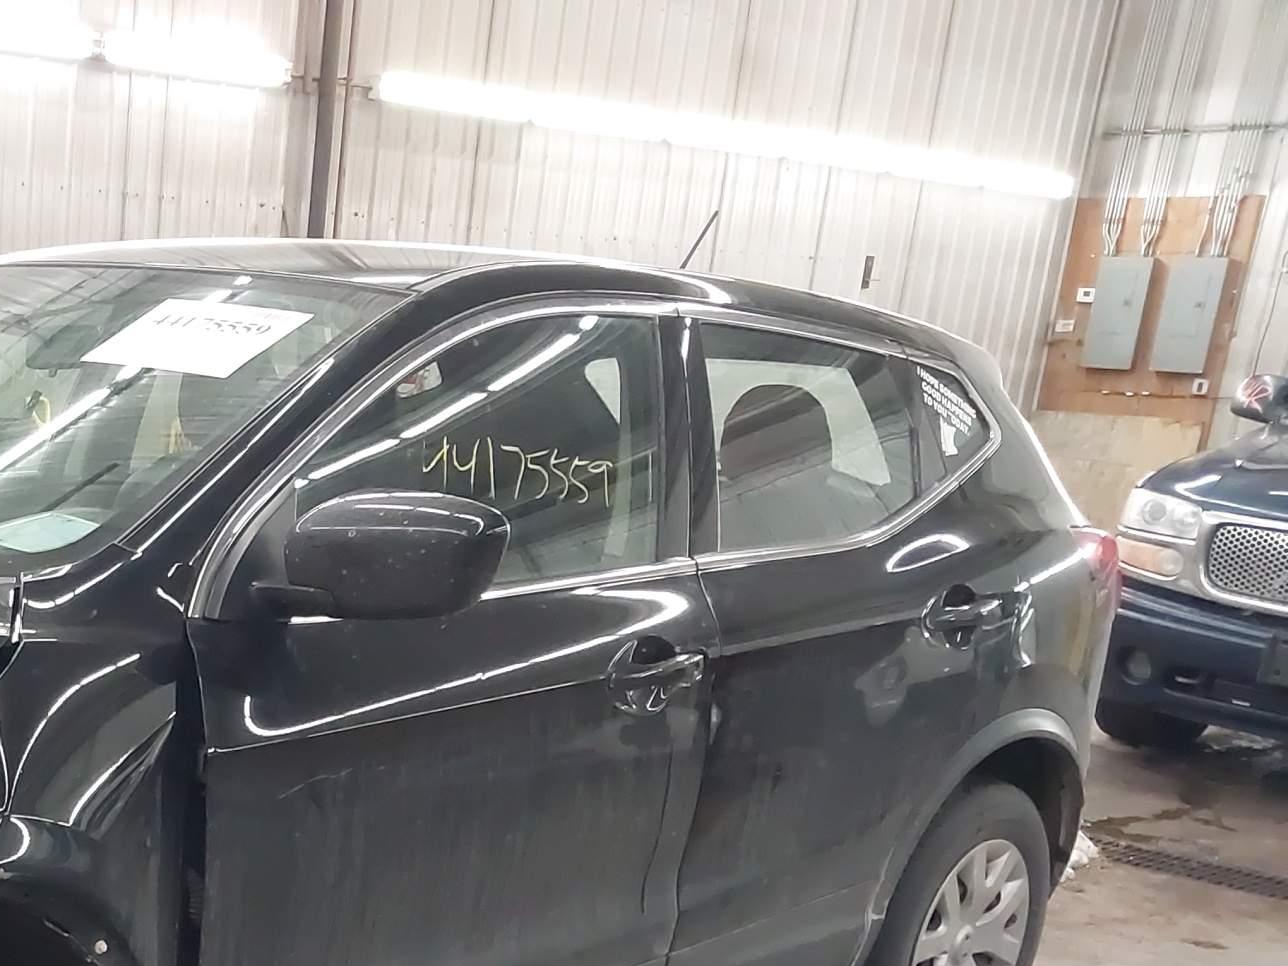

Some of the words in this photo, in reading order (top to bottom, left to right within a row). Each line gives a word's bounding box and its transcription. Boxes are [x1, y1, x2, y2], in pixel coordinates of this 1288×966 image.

[920, 368, 939, 390] HOPE
[921, 381, 942, 402] GOOD
[941, 395, 972, 427] HAPPENS
[923, 392, 933, 407] TO
[933, 399, 948, 418] YOU
[422, 435, 614, 508] 44175559
